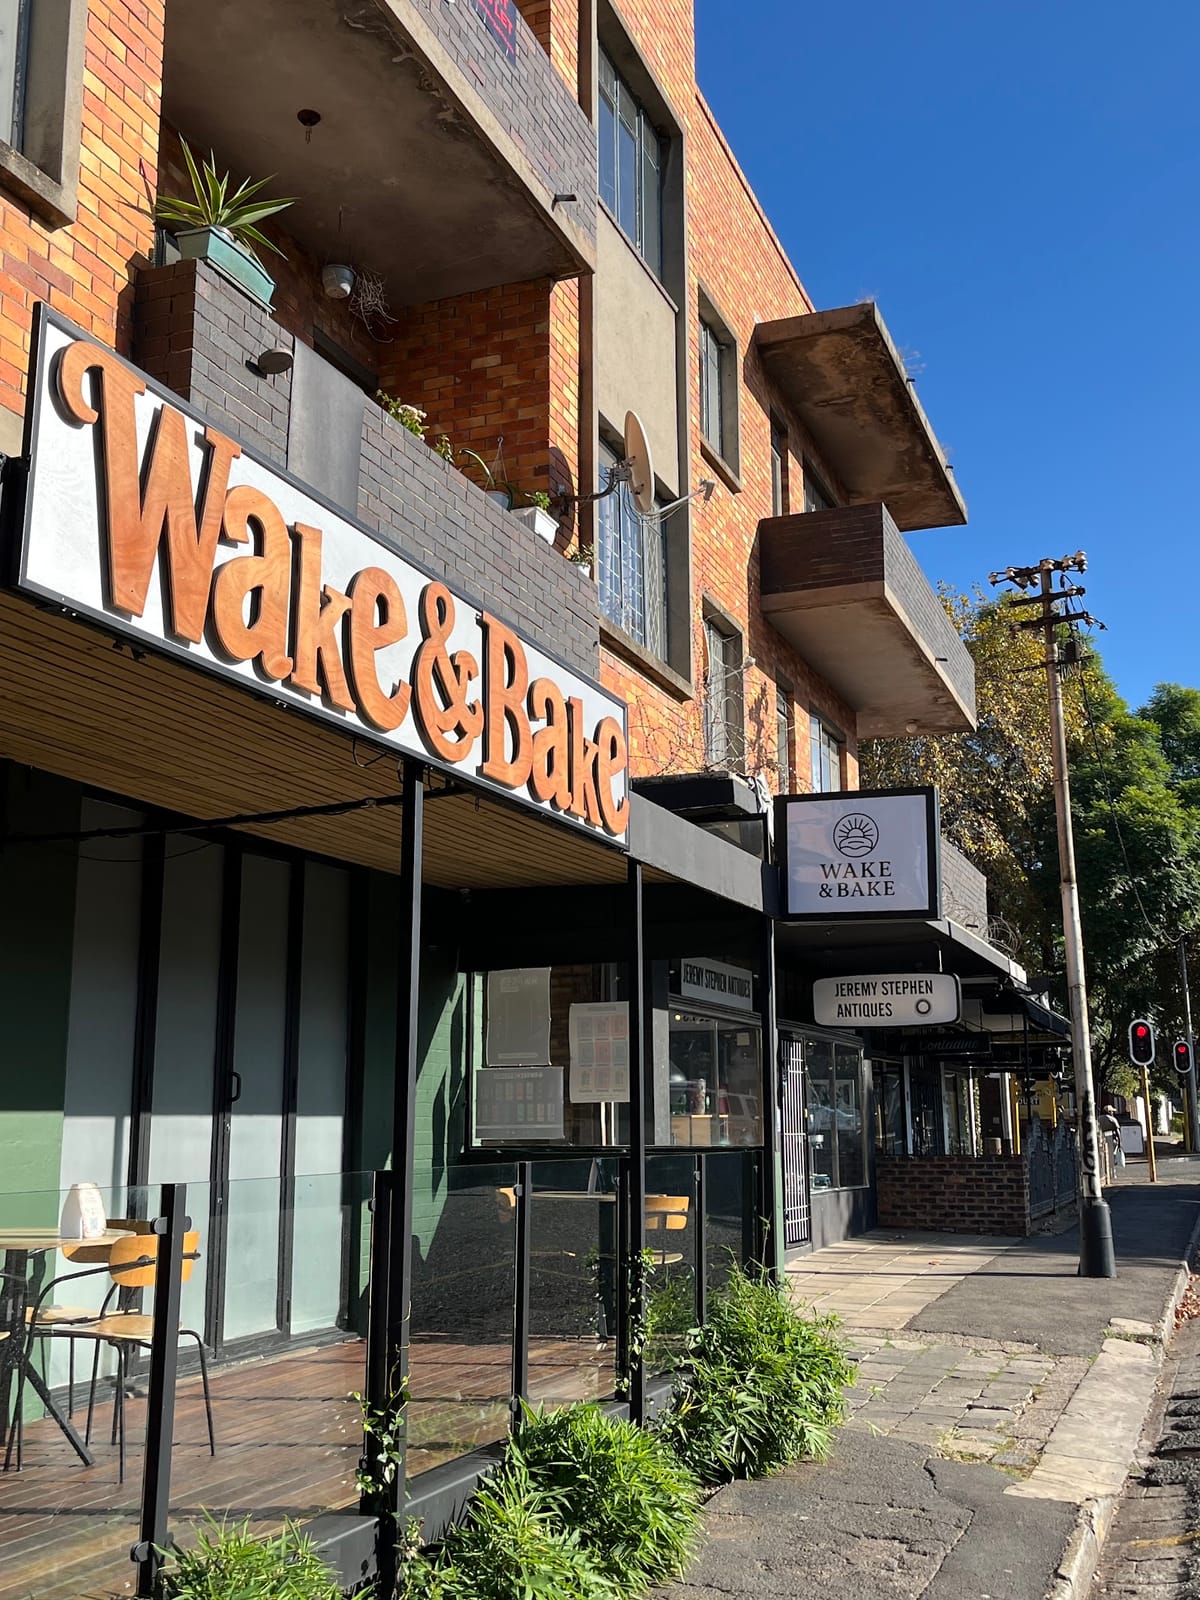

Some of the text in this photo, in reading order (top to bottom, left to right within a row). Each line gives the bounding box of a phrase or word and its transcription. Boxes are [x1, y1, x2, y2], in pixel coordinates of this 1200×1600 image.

[820, 861, 892, 879] WAKE
[834, 980, 933, 997] JEREMY STEPHEN
[837, 1002, 893, 1018] ANTIQUES
